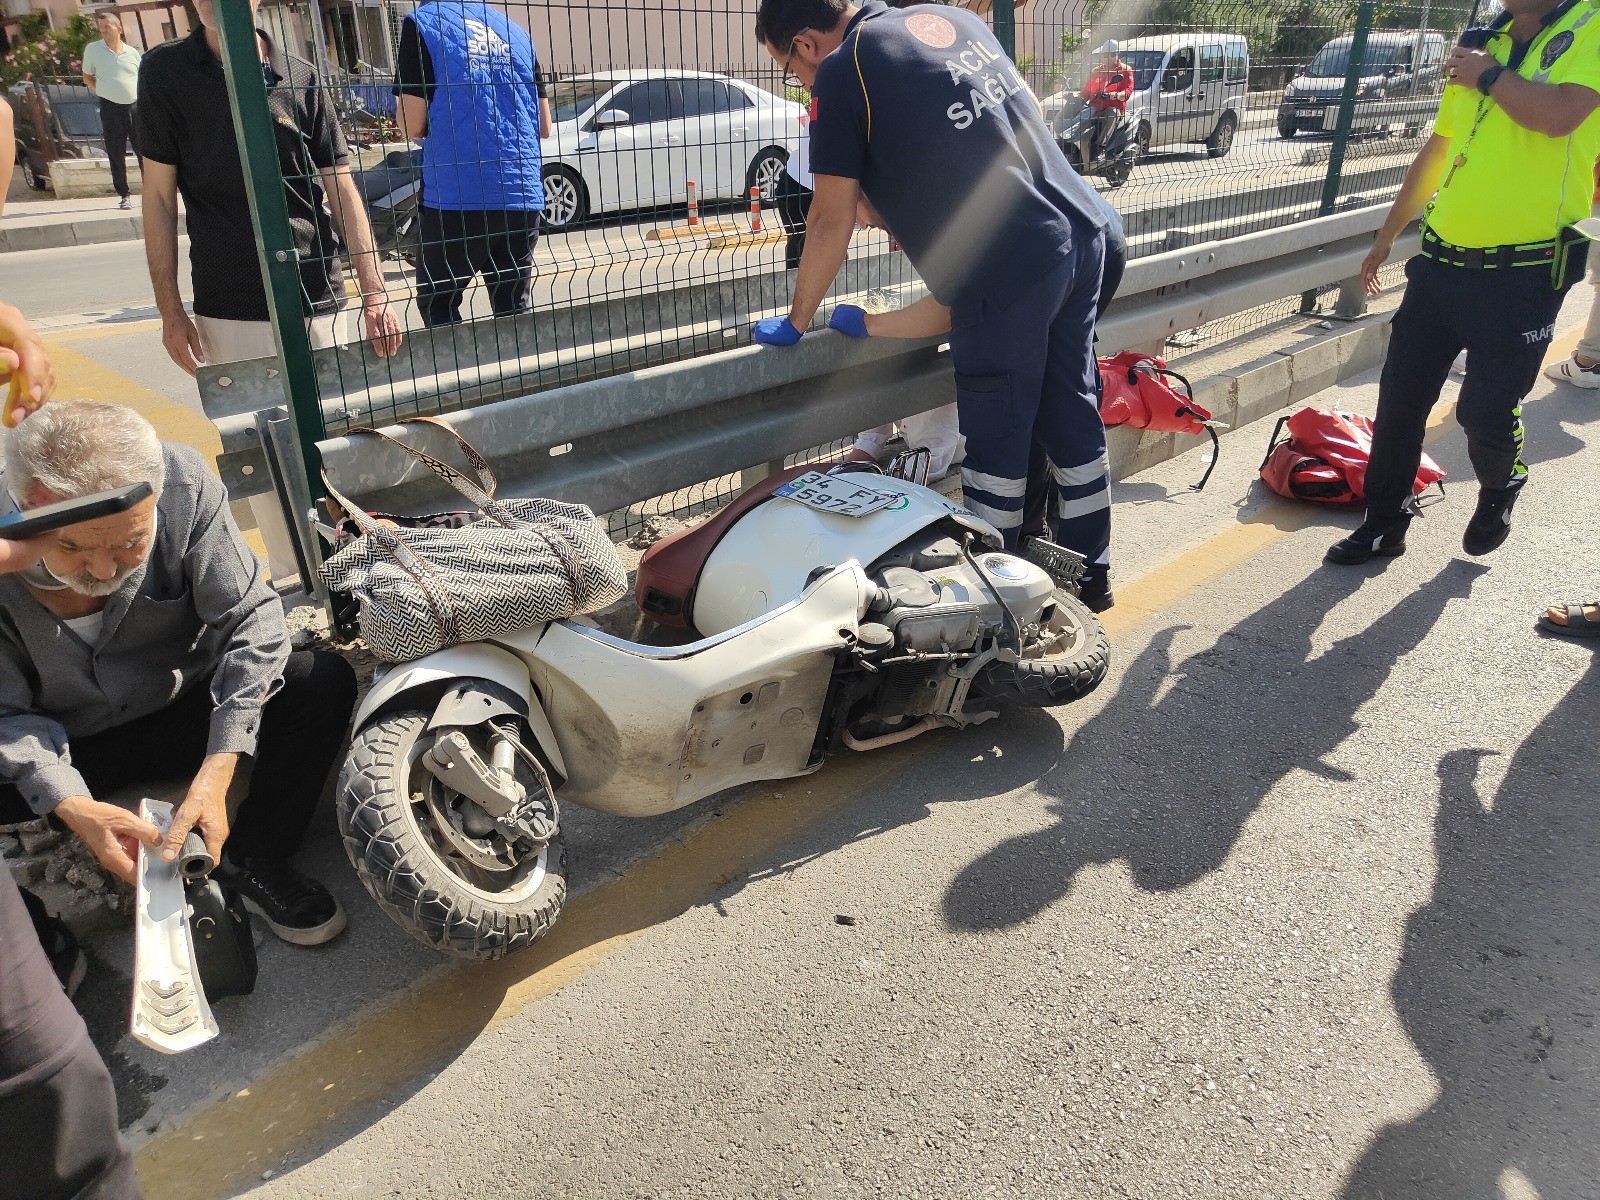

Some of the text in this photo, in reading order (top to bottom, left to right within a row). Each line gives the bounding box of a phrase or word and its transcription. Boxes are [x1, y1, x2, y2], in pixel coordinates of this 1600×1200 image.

[468, 40, 511, 57] SONIC
[945, 40, 1000, 86] ACİL
[795, 488, 863, 513] 5972
[801, 473, 833, 489] 34
[848, 489, 886, 505] FY
